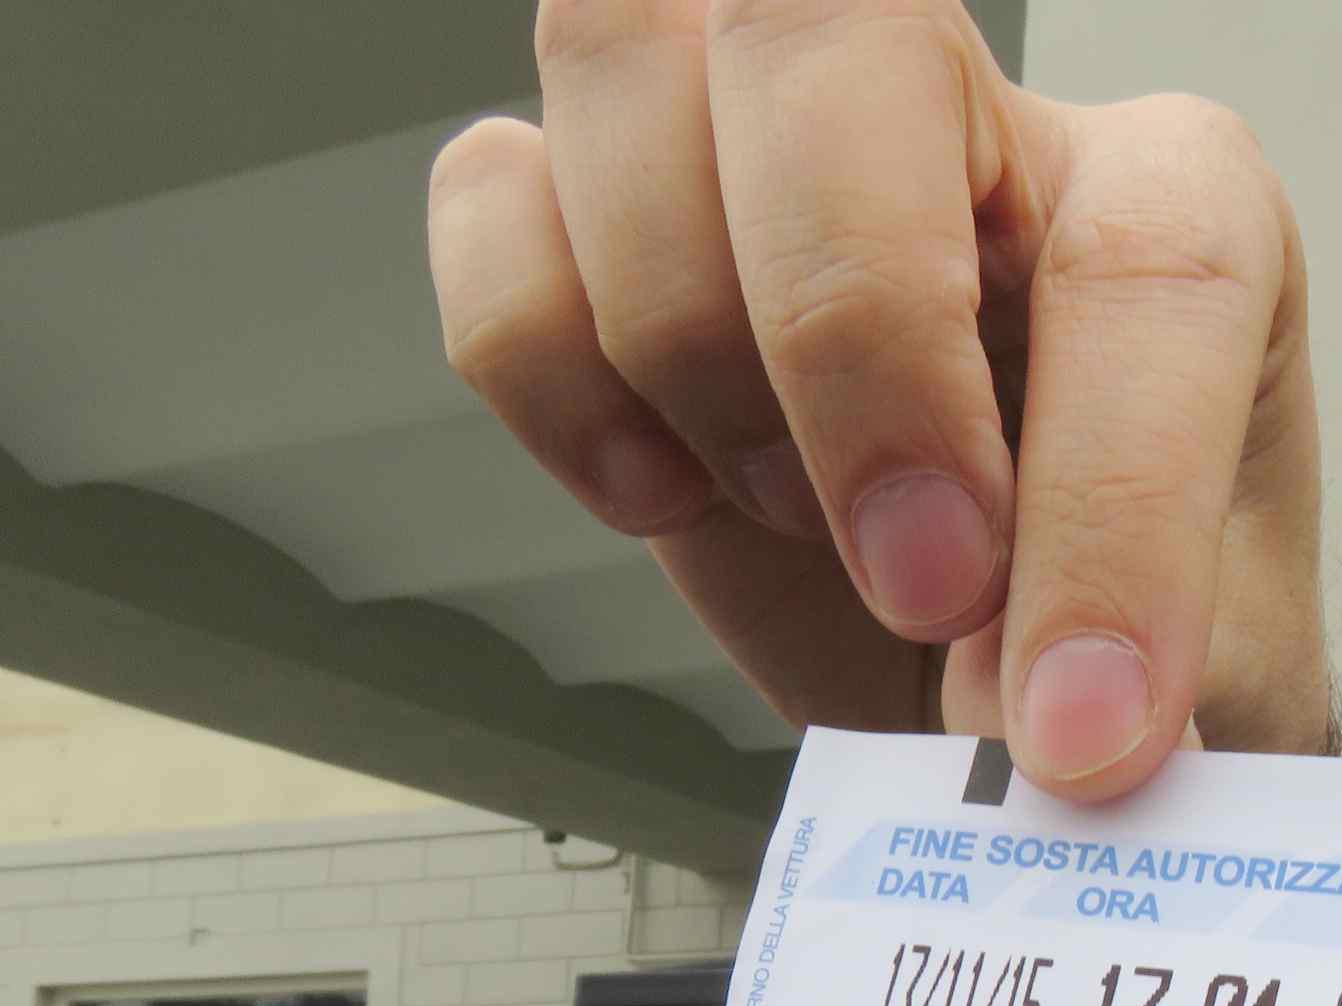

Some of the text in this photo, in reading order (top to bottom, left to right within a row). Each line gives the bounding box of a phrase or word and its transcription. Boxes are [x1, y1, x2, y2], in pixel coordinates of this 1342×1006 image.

[887, 827, 978, 862] FINE
[986, 834, 1119, 878] SOSTA
[759, 905, 788, 965] DELLA
[781, 816, 817, 899] VETTURA
[876, 869, 1160, 923] DATA ORA
